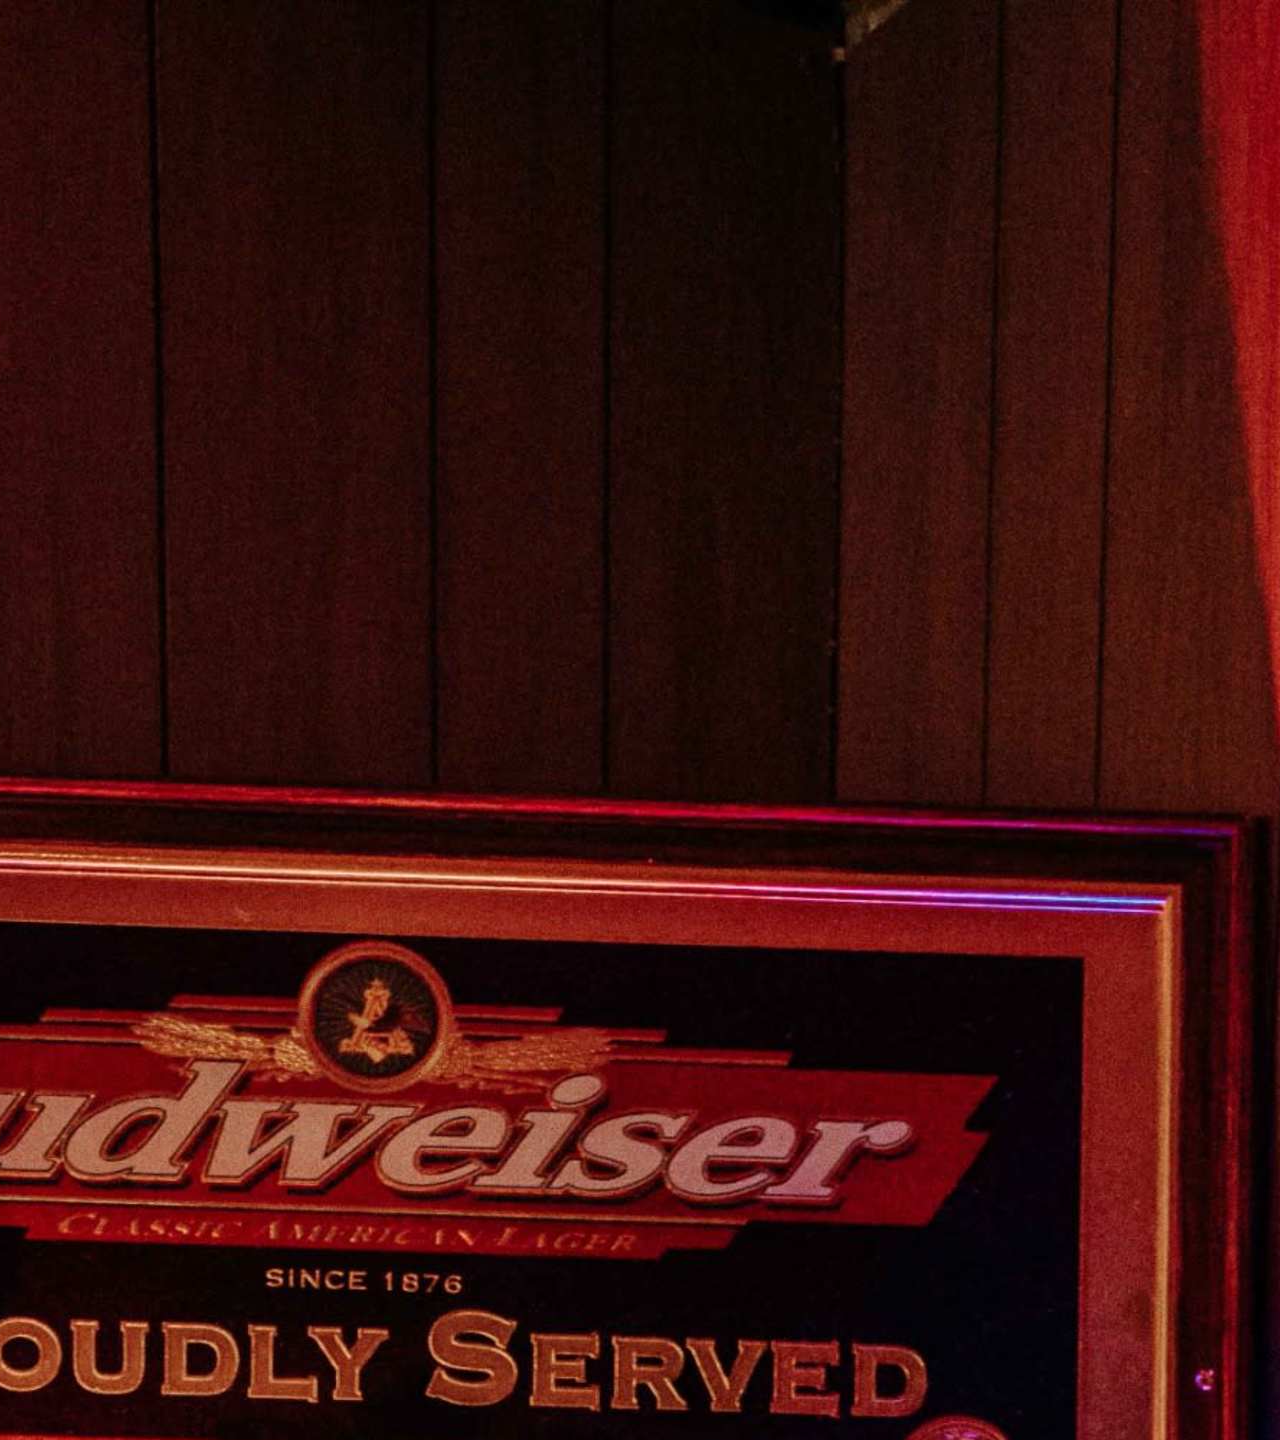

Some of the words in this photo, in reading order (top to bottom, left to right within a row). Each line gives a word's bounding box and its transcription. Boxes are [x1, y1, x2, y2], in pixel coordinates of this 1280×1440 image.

[494, 1225, 638, 1251] LAGER
[265, 1267, 368, 1291] SINCE
[383, 1270, 463, 1294] 1876
[425, 1308, 928, 1419] SERVED
